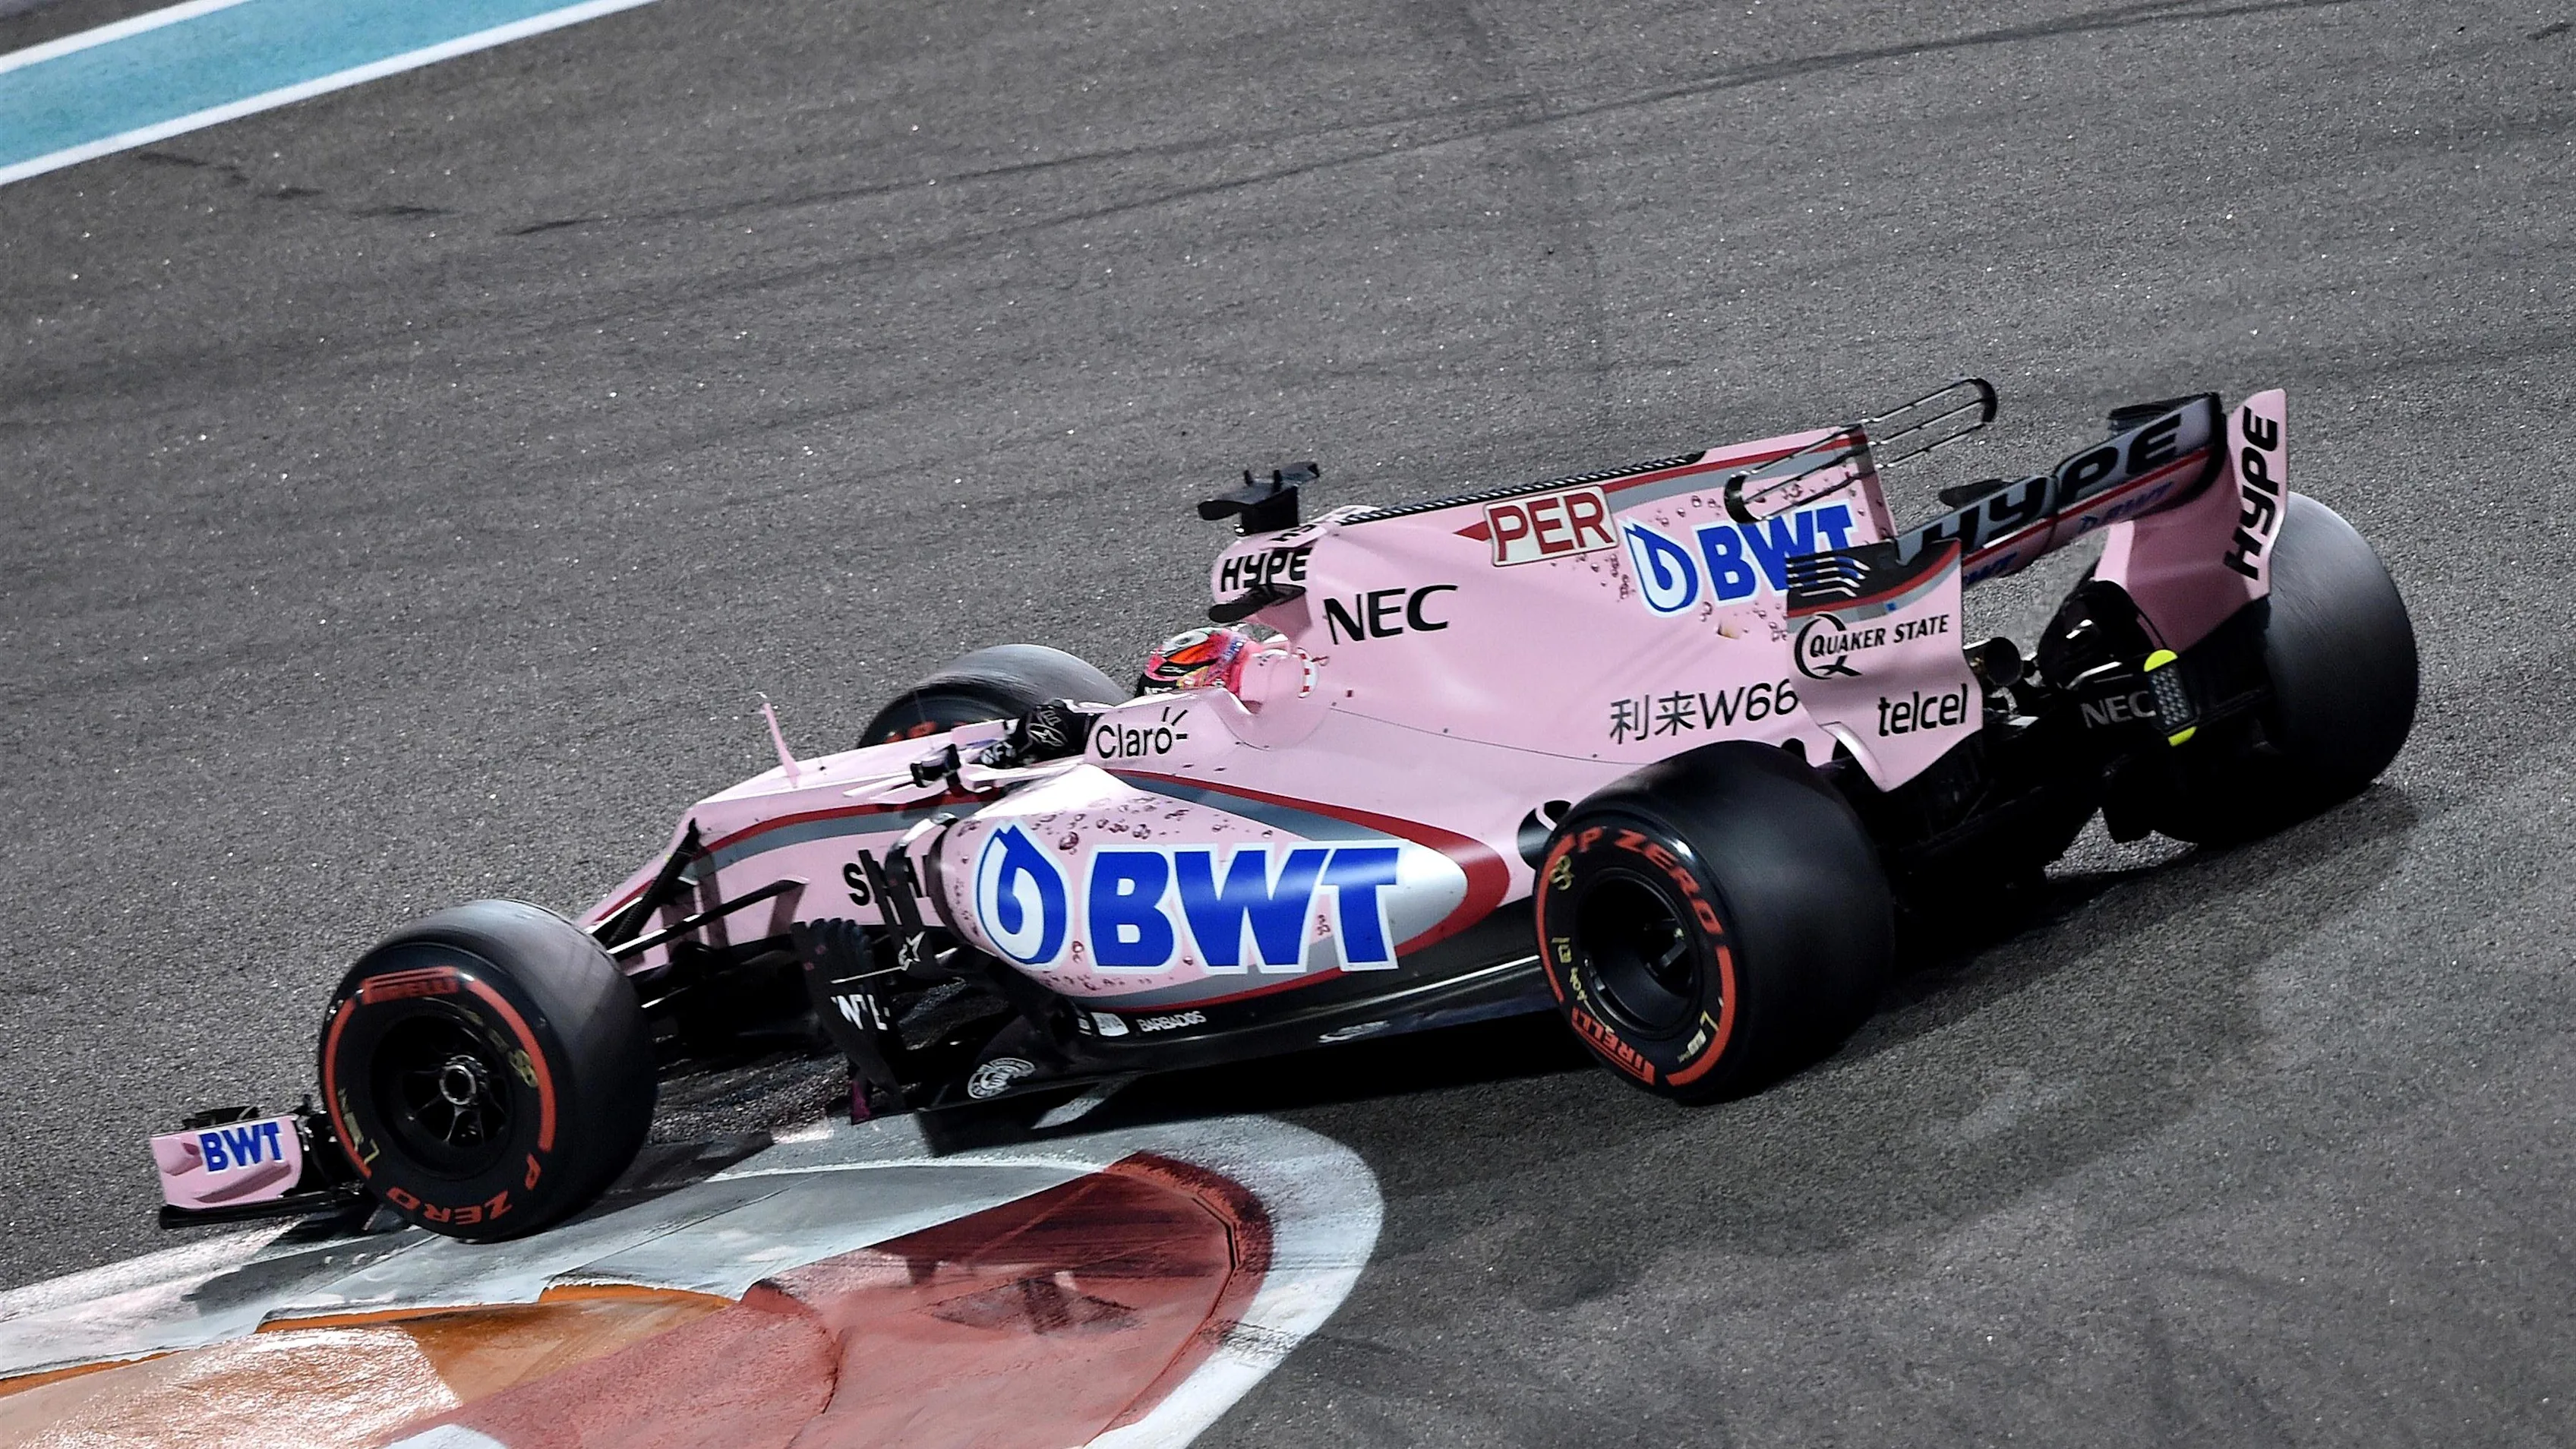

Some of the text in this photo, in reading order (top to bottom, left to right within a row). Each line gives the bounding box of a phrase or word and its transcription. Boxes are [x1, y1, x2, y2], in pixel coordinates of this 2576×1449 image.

[1920, 412, 2182, 555] HYPE
[2223, 405, 2278, 580] HYPE
[1488, 491, 1615, 562] PER
[1697, 504, 1853, 602] BWT
[1220, 546, 1313, 592] HYPE
[1323, 584, 1458, 645] NEC
[1810, 614, 1950, 658] QUAKER STATE
[1096, 723, 1173, 759] Claro
[1609, 678, 1798, 745] 利来W66
[1877, 683, 1968, 737] telcel
[2080, 690, 2157, 729] NEC
[1088, 846, 1401, 968] BWT
[1577, 826, 1605, 853] P
[1614, 828, 1725, 935] ZERO
[1135, 1010, 1208, 1033] BARBADOS
[1571, 1006, 1656, 1087] PIRELLI
[198, 1121, 283, 1173] BWT
[386, 1153, 541, 1226] P ZERO
